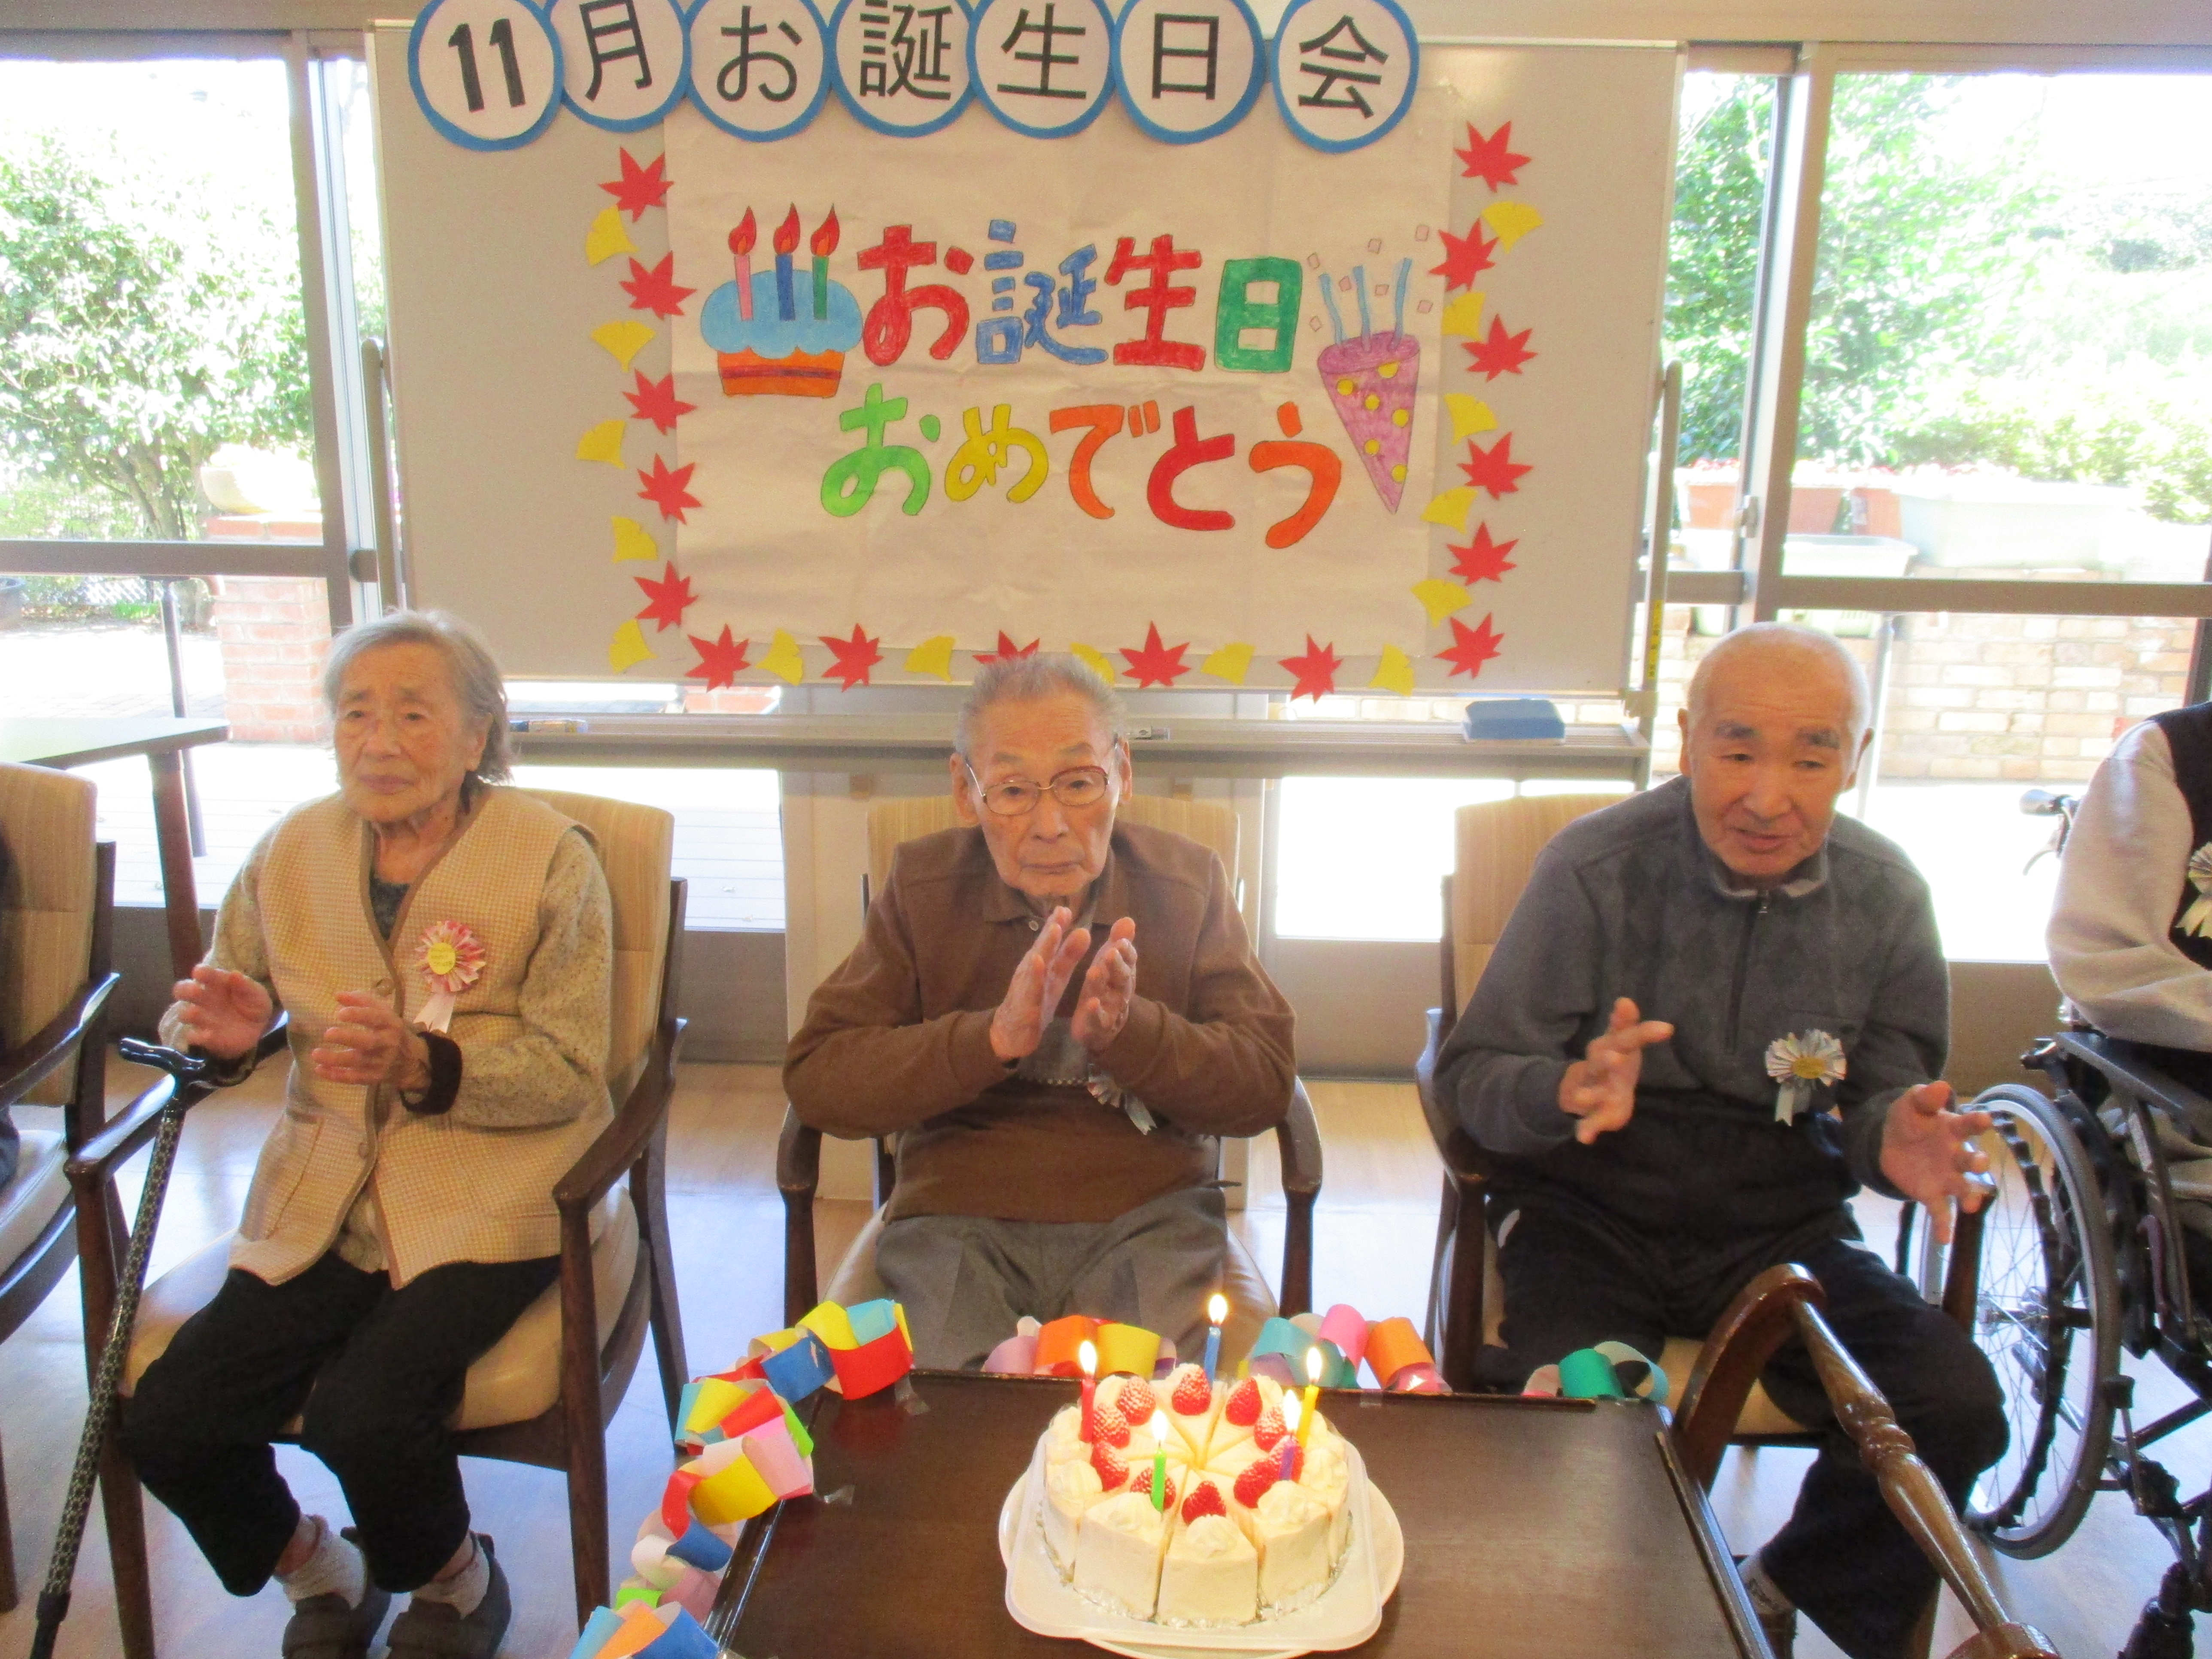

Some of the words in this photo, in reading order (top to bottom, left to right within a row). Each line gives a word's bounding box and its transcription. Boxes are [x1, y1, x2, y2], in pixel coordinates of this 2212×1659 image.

[448, 0, 1385, 117] 11月お誕生日会
[858, 219, 1302, 373] お誕生日
[820, 383, 1341, 548] おめでとう
